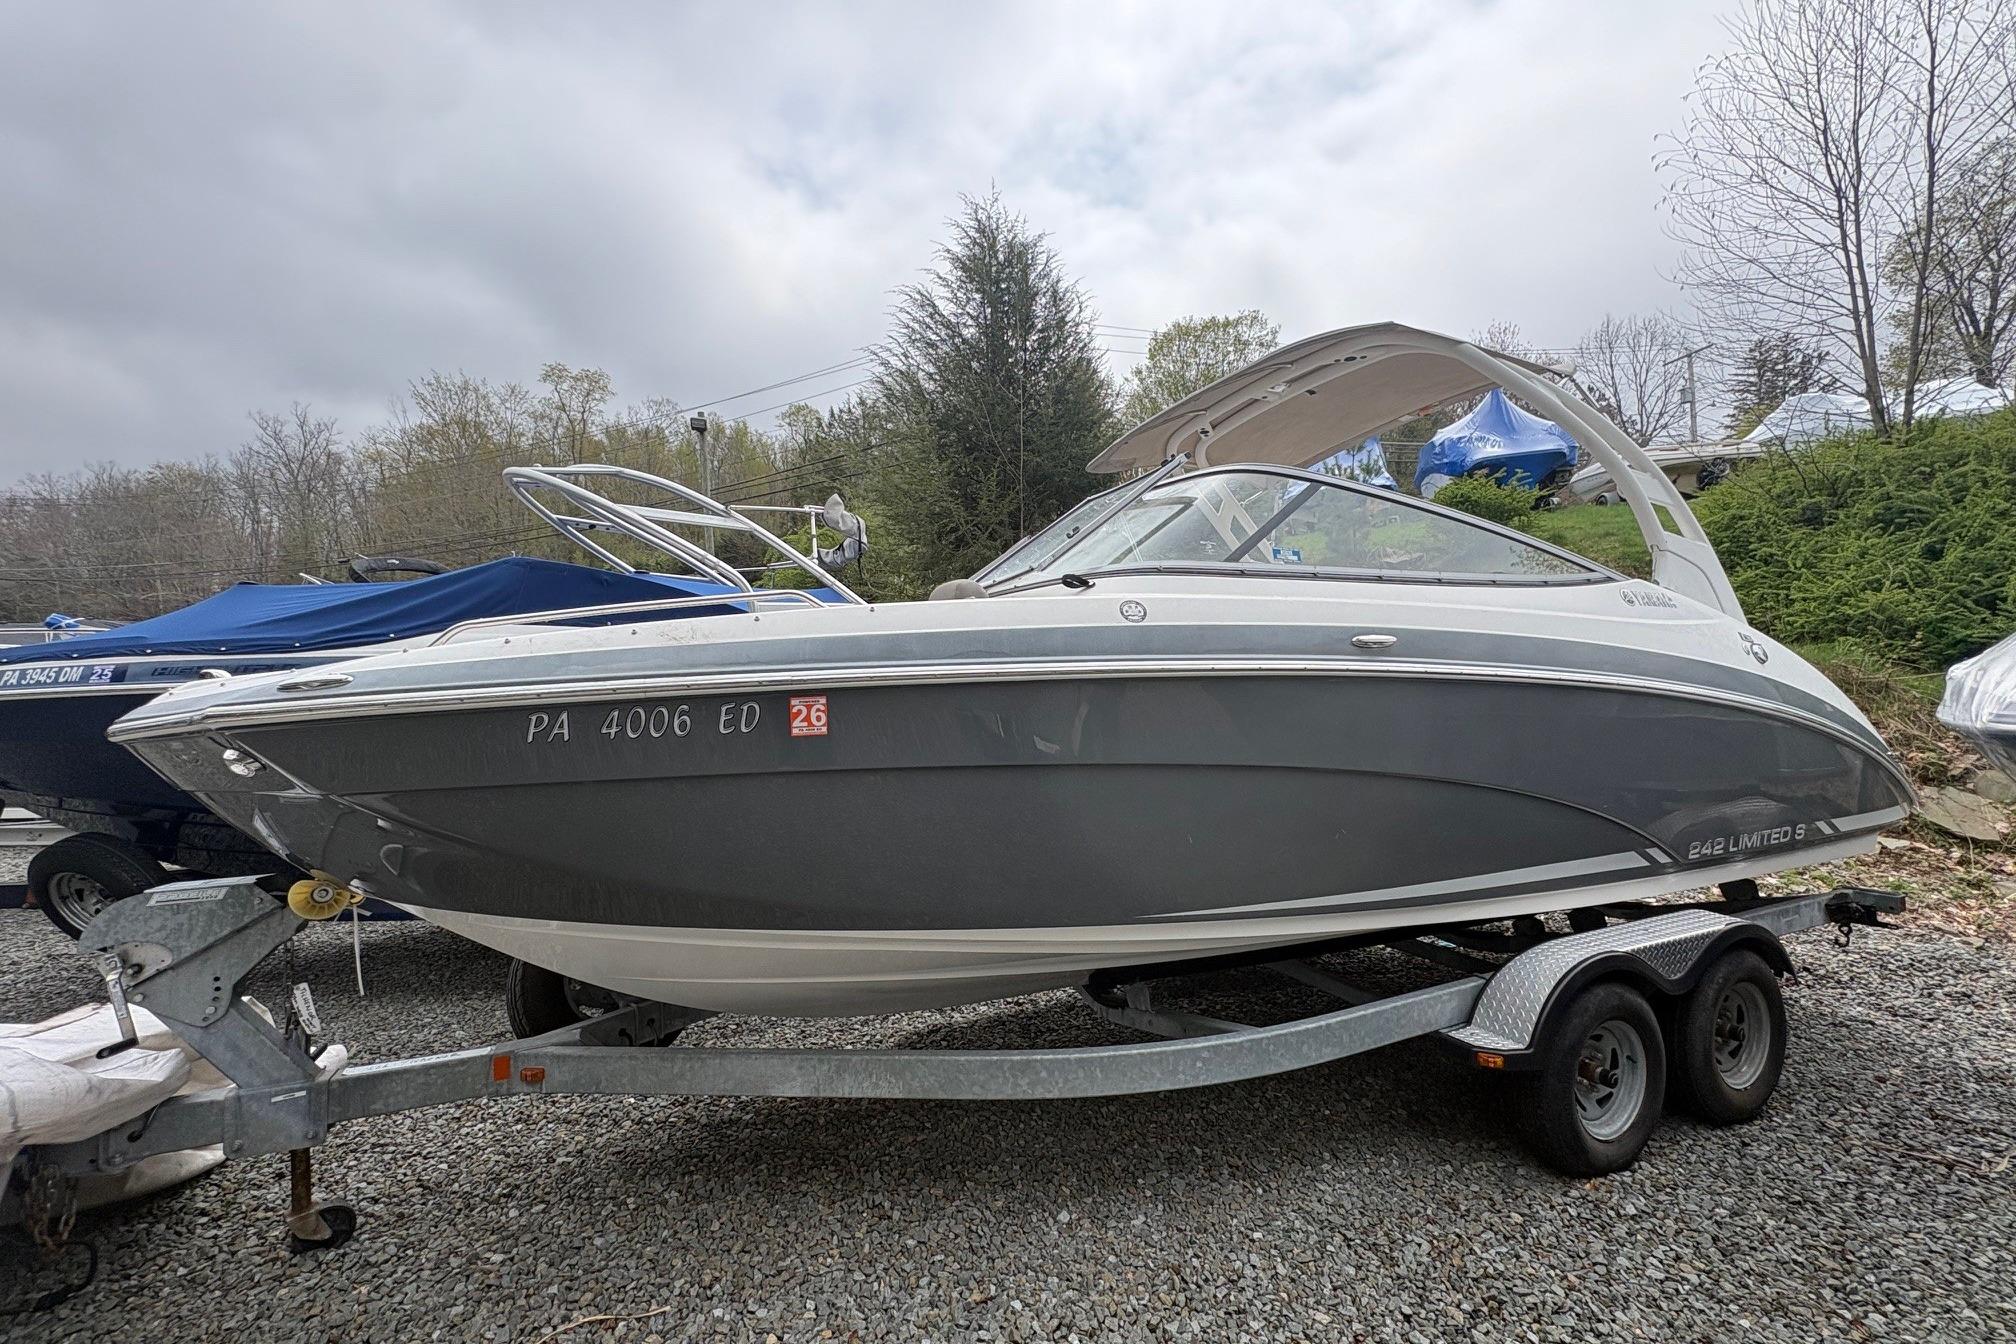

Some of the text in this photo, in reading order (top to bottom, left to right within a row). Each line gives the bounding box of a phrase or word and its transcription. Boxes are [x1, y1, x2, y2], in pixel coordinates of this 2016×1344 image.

[0, 666, 85, 686] PA 3945 DM
[90, 668, 113, 680] 25
[526, 701, 761, 743] PA 4006 ED
[791, 704, 827, 727] 26
[1688, 823, 1806, 860] 242 LIMITED S
